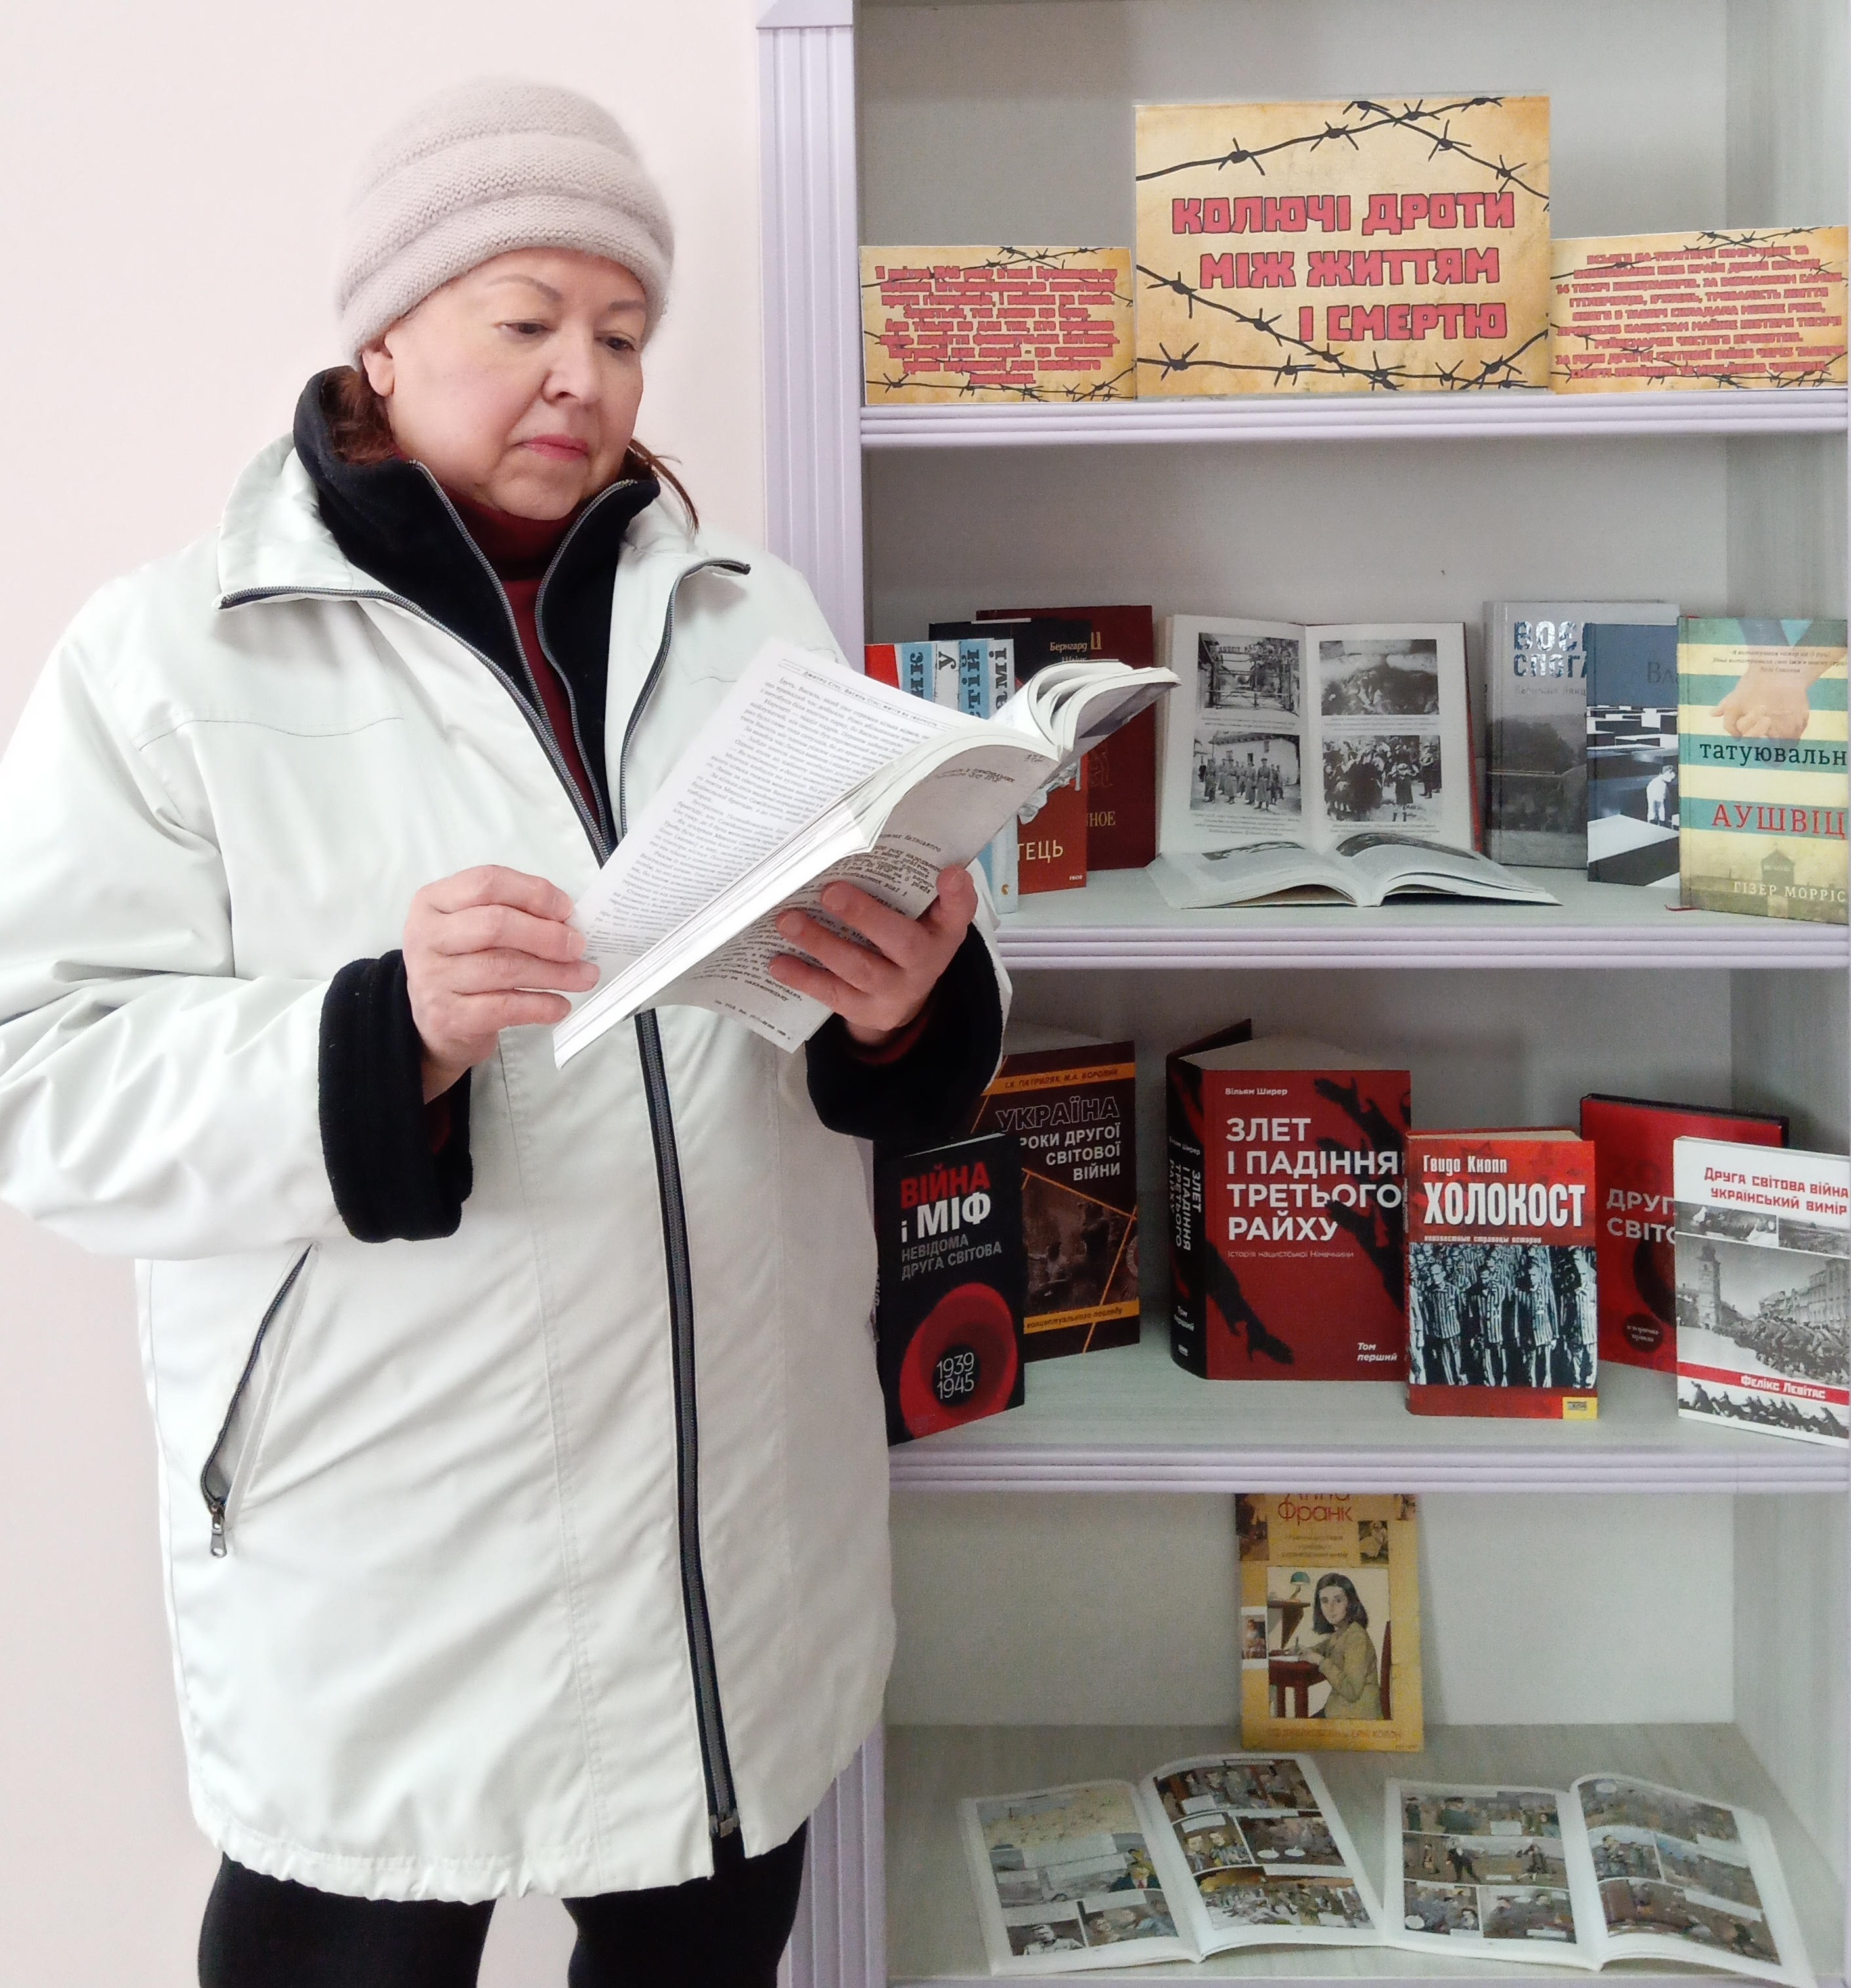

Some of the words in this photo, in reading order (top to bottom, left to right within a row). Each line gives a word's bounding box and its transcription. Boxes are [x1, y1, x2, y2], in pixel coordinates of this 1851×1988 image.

[1172, 195, 1351, 235] КОЛЮЧІ
[1362, 192, 1515, 235] ДРОТИ
[1200, 251, 1294, 289] МІЖ
[1308, 247, 1499, 287] ЖИТТЯМ
[1298, 306, 1314, 342] І
[1327, 302, 1507, 340] СМЕРТЮ
[1050, 641, 1088, 653] Бернгард
[1700, 743, 1847, 767] татуювальн
[1712, 804, 1846, 841] АУШВІЦ
[1733, 881, 1777, 896] ГІЗЕР
[1785, 887, 1846, 902] МОРРІС
[1257, 1088, 1288, 1096] Ширер
[995, 1096, 1120, 1132] УКРАЇНА
[1064, 1122, 1121, 1147] ДРУГОЇ
[1226, 1118, 1312, 1142] ЗЛЕТ
[1046, 1141, 1122, 1165] СВІТОВОЇ
[1227, 1151, 1235, 1174] І
[1246, 1151, 1398, 1179] ПАДІННЯ
[1423, 1155, 1461, 1176] Гвидо
[1467, 1155, 1507, 1173] Кнопп
[901, 1162, 991, 1209] ВІЙНА
[1073, 1162, 1120, 1181] ВІЙНИ
[1192, 1170, 1202, 1213] ЗЛЕТ
[1227, 1184, 1402, 1209] ТРЕТЬОГО
[1423, 1182, 1586, 1227] ХОЛОКОСТ
[1607, 1188, 1676, 1216] ДРУГ
[917, 1192, 991, 1239] МІФ
[1182, 1176, 1191, 1251] ПАДІННЯ
[1228, 1210, 1338, 1241] РАЙХУ
[902, 1234, 969, 1262] НЕВІДОМА
[902, 1257, 945, 1281] ДРУГА
[948, 1241, 1002, 1266] СВІТОВА
[1357, 1352, 1398, 1362] перший
[1358, 1342, 1377, 1351] Том
[936, 1352, 974, 1379] 1939
[937, 1372, 974, 1400] 1945
[1278, 1499, 1354, 1526] Франк
